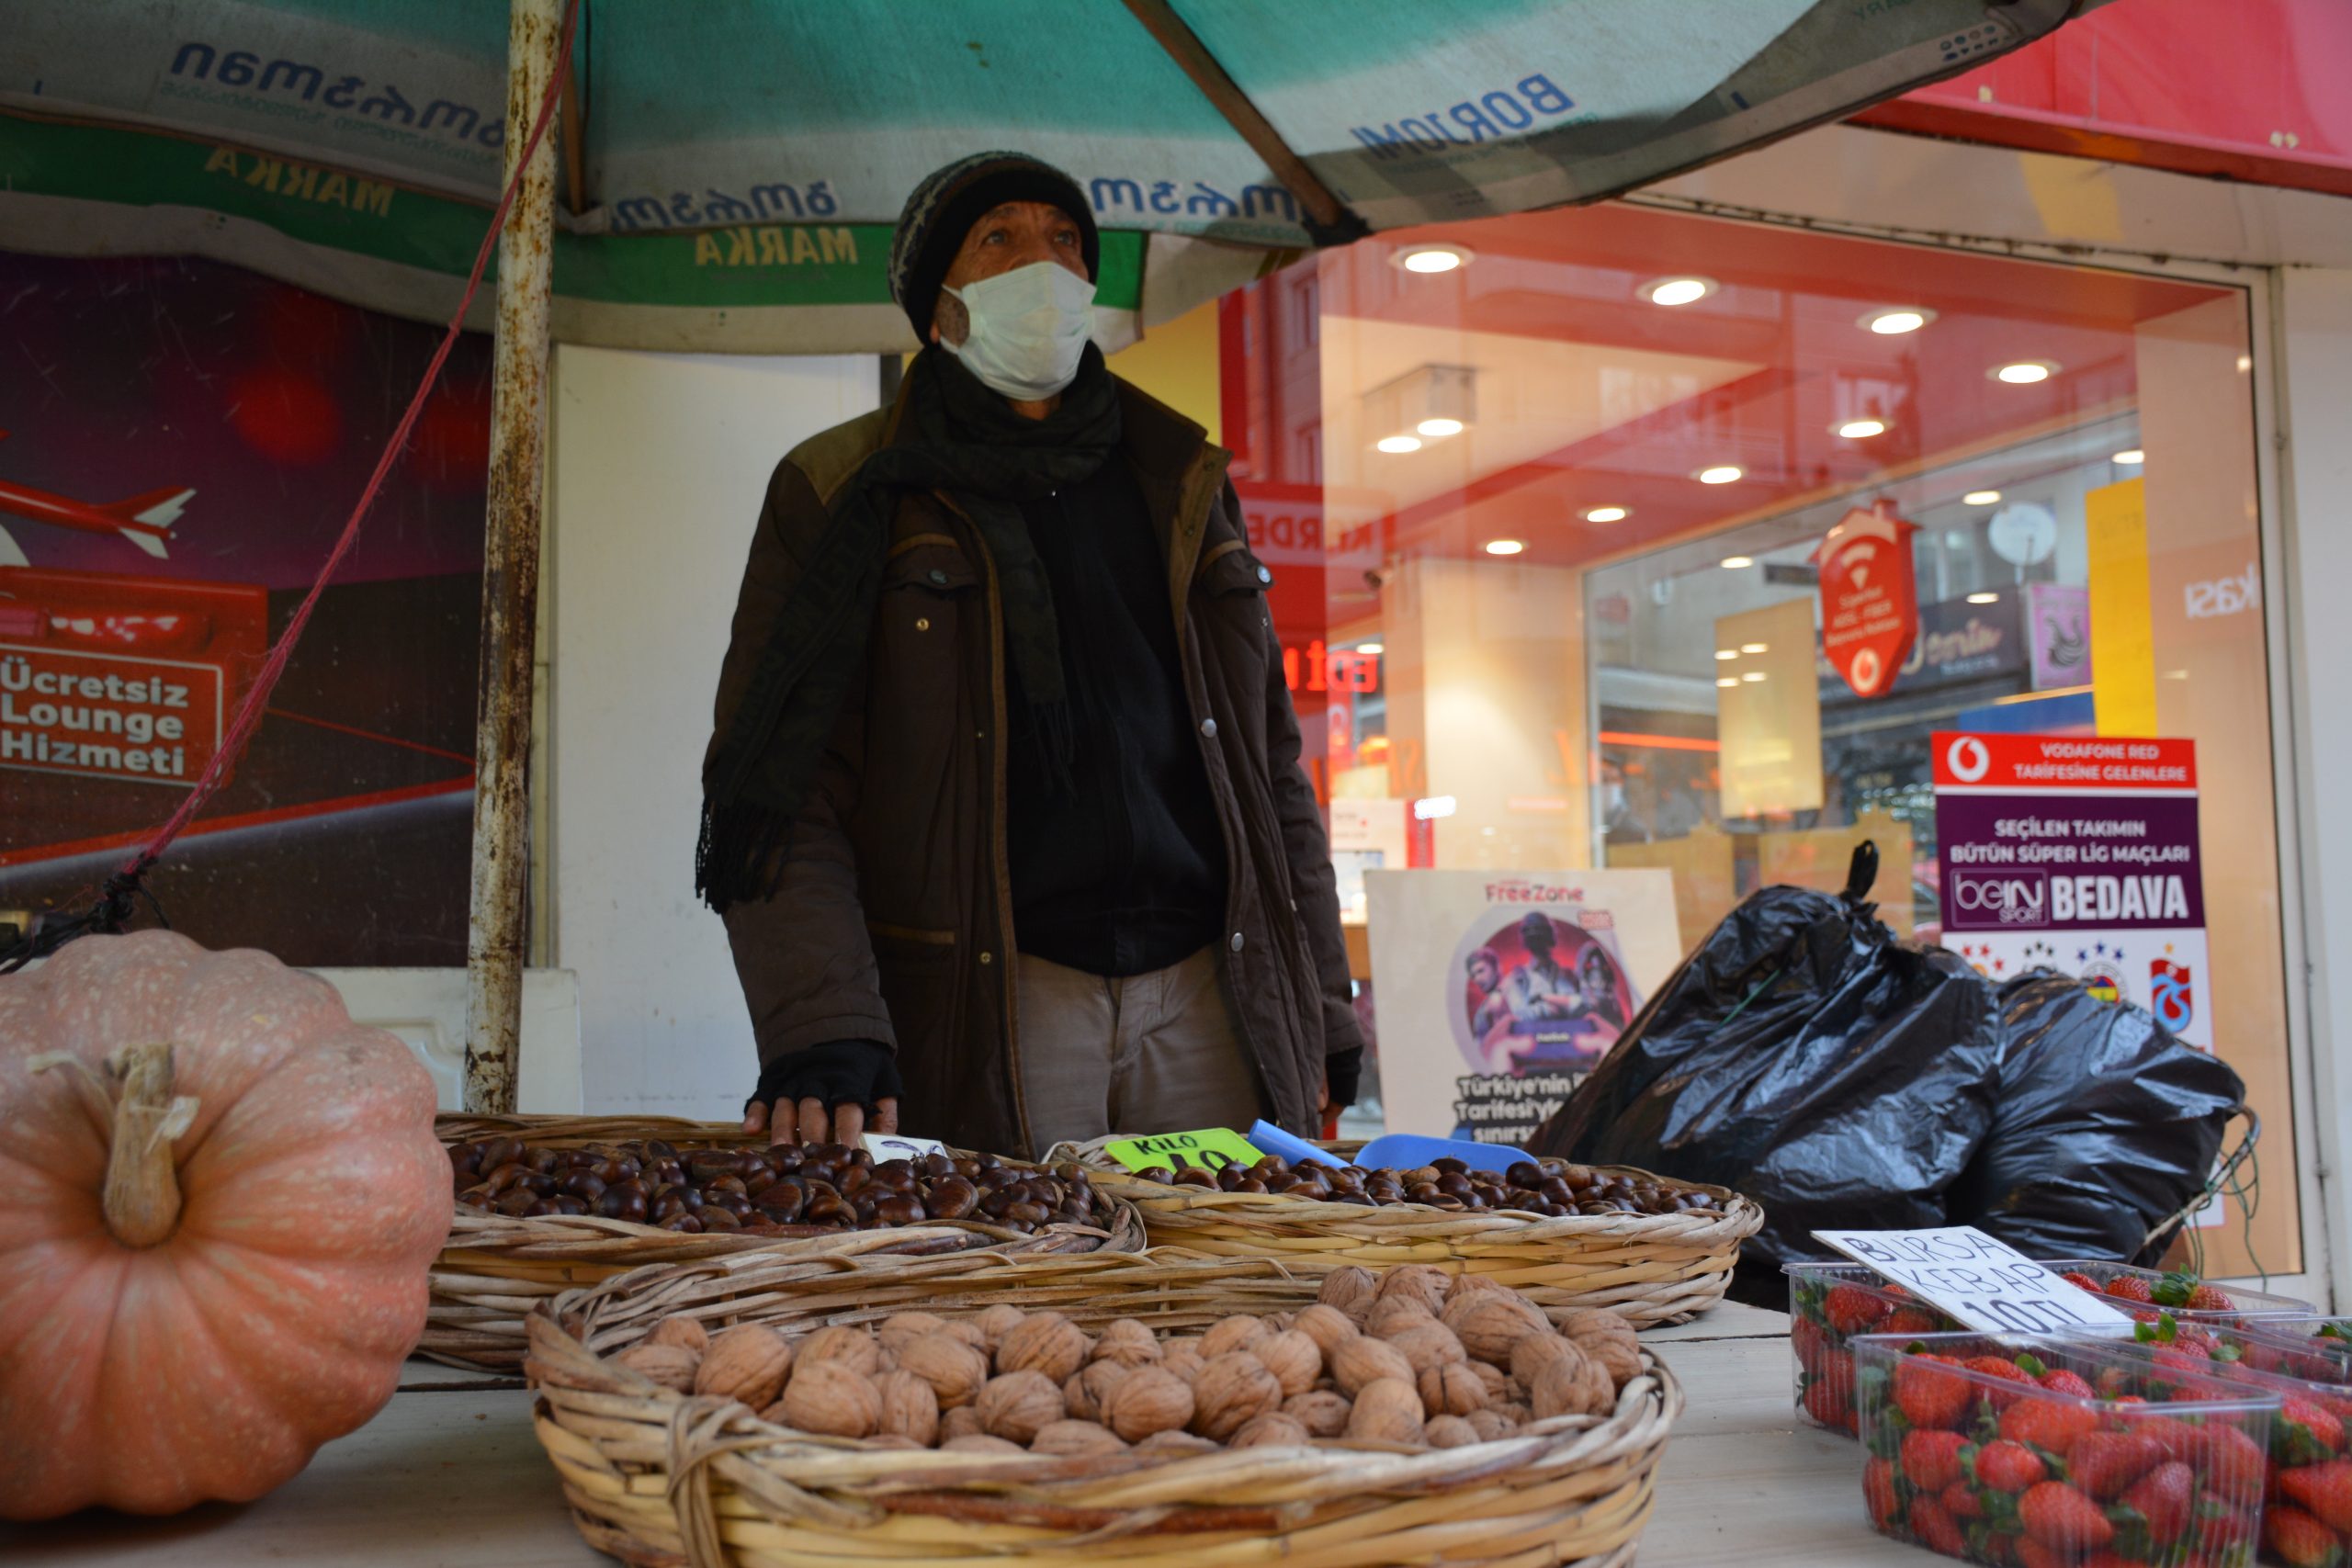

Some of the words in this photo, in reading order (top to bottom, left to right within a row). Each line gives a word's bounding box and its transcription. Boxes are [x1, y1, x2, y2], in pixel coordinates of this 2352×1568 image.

[1, 656, 189, 708] Ücretsiz
[1, 694, 184, 744] Lounge
[1, 730, 185, 776] Hizmeti
[2040, 742, 2125, 761] VODAFONE
[2128, 744, 2160, 761] RED
[2013, 761, 2100, 782] TARİFESİNE
[2103, 764, 2188, 783] GELENLERE
[1995, 816, 2070, 840] SEÇİLEN
[2073, 819, 2146, 838] TAKIMIN
[1950, 841, 2015, 863] BÜTÜN
[2017, 841, 2076, 863] SÜPER
[2112, 845, 2190, 866] MAÇLARI
[1485, 884, 1584, 903] FreeZone
[2050, 874, 2190, 920] BEDAVA
[1457, 1073, 1570, 1099] Türkiye'nin
[1841, 1233, 2015, 1262] BURSA
[1890, 1262, 2050, 1294] KEBAP
